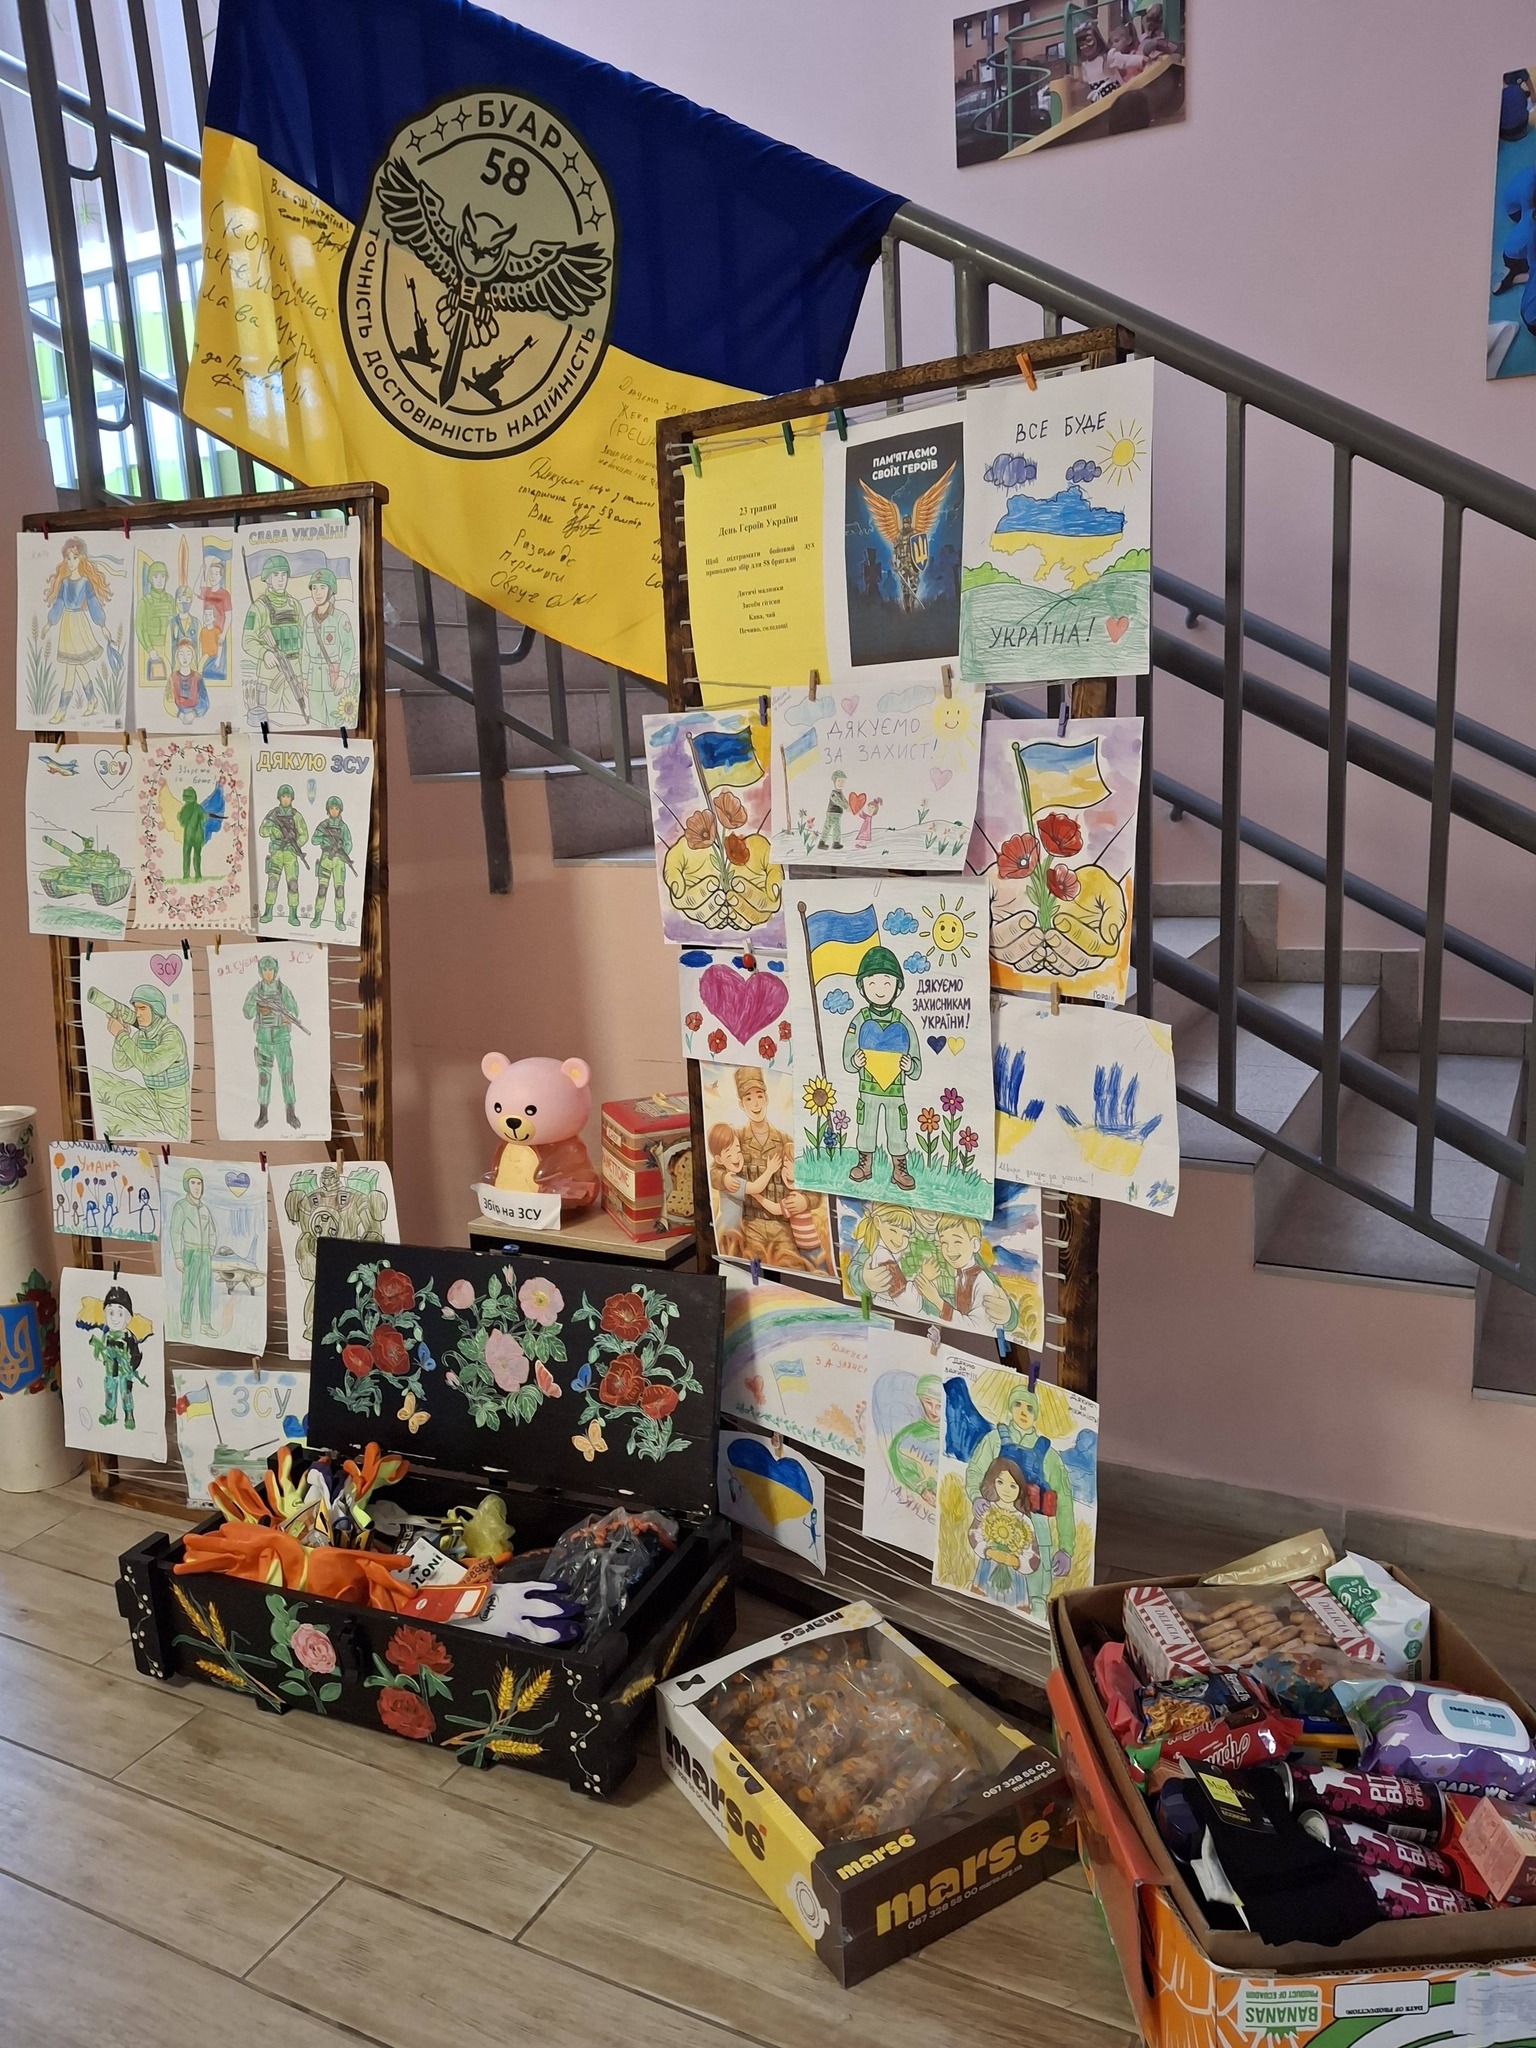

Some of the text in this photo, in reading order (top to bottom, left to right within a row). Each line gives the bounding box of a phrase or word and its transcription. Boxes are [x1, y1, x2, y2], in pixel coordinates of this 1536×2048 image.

[478, 99, 562, 150] БУАР
[480, 147, 531, 196] 58
[356, 228, 596, 443] ТОЧНІСТЬ ДОСТОВІРНІСТЬ НАДІЙНІСТЬ
[1015, 411, 1108, 444] ВСЕ БУДЕ
[872, 445, 938, 468] ПАМ'ЯТАЄМО
[872, 458, 939, 481] СВОЇХ ГЕРОЇВ
[739, 502, 777, 516] 23 травня
[248, 527, 289, 546] СЛАВА
[718, 515, 799, 537] День Героїв України
[988, 616, 1097, 649] УКРАЇНА!
[826, 717, 921, 741] ДЯКУЄМО
[255, 750, 370, 775] ДЯКУЮ ЗСУ
[823, 739, 938, 765] ЗА ЗАХИСТ!
[99, 760, 128, 777] ЗСУ
[156, 961, 178, 977] ЗСУ
[915, 978, 964, 995] ДЯКУЄМО
[912, 997, 971, 1012] ЗАХИСНИКАМ
[920, 1012, 970, 1030] УКРАЇНИ!
[482, 1196, 542, 1222] Збір на ЗСУ
[230, 1386, 292, 1419] ЗСУ
[1154, 1608, 1185, 1641] DELICIA
[1318, 1600, 1354, 1634] DELICIA
[982, 1785, 1002, 1799] 067
[1035, 1760, 1051, 1774] 00
[1369, 1773, 1387, 1802] PIT
[1288, 1989, 1319, 2000] PRODUCT
[1245, 2005, 1319, 2024] BANANAS
